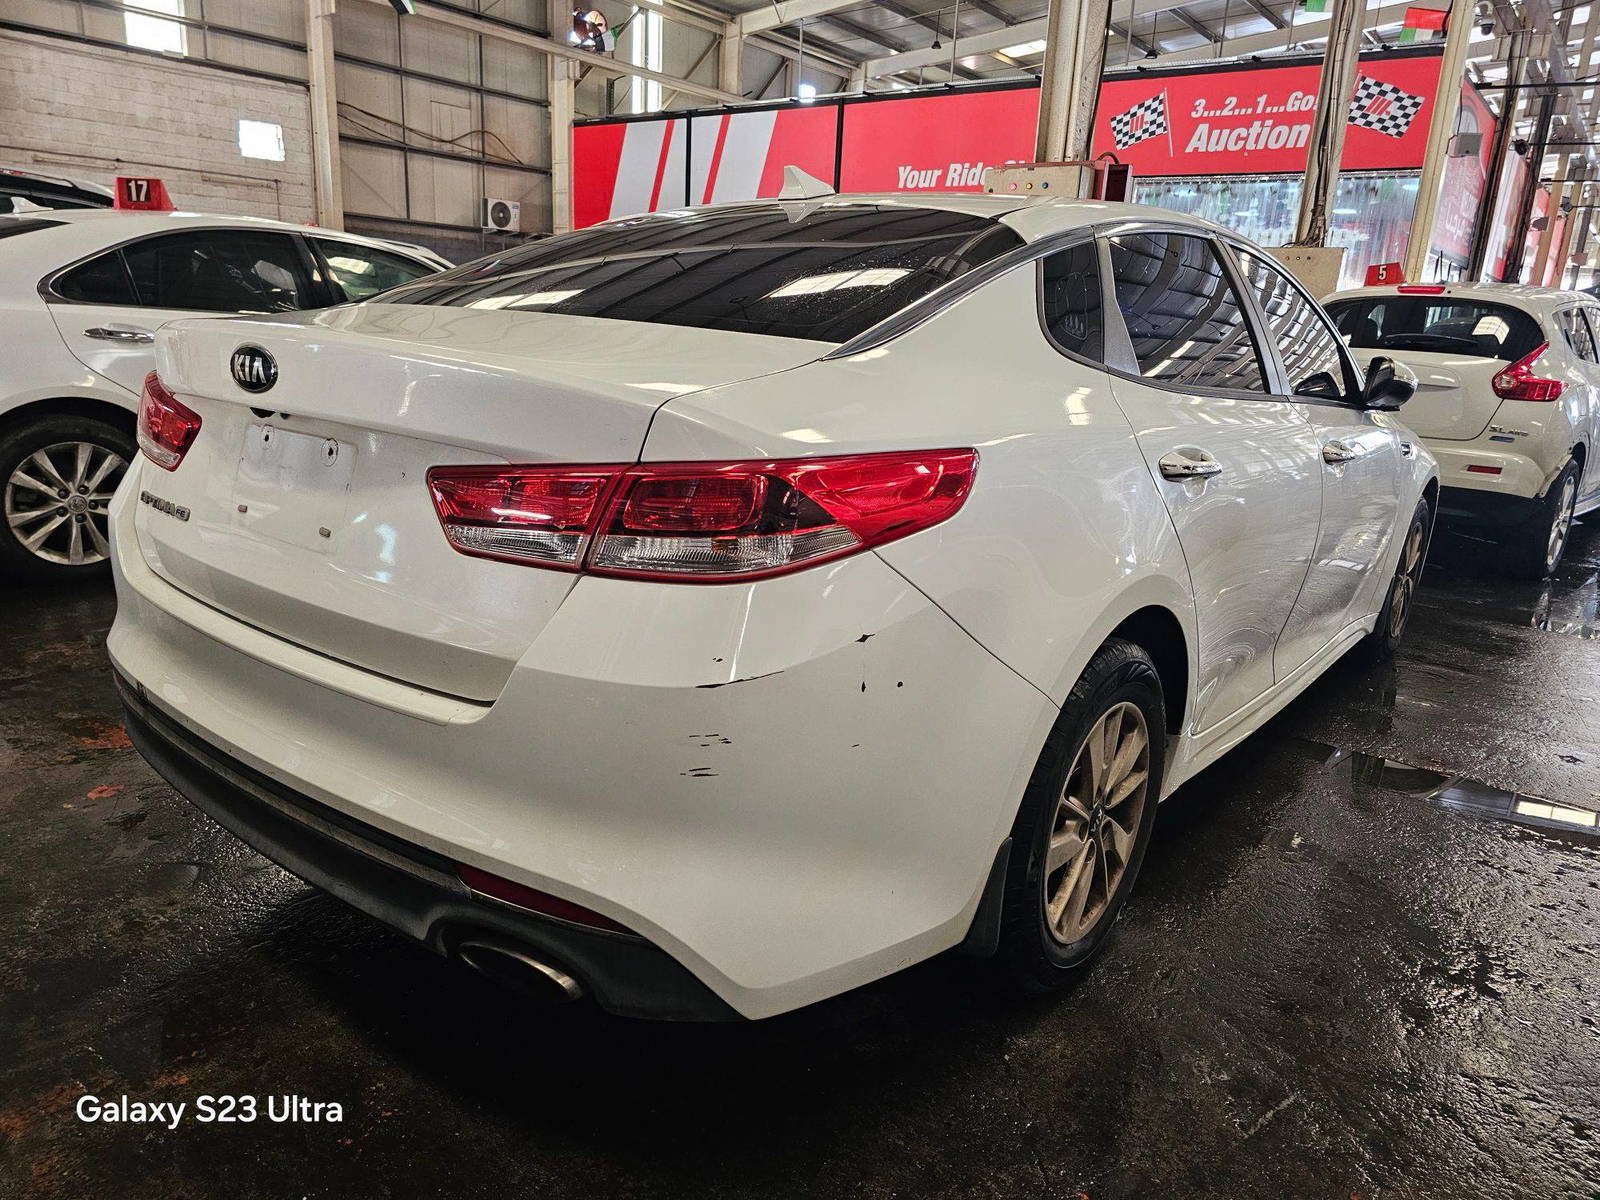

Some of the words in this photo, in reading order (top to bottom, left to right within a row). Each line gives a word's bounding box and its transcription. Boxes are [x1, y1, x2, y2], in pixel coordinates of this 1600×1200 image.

[1185, 119, 1311, 153] Auction
[897, 165, 943, 189] Your
[128, 180, 148, 202] 17
[1378, 265, 1387, 280] 5
[233, 353, 267, 384] KIA
